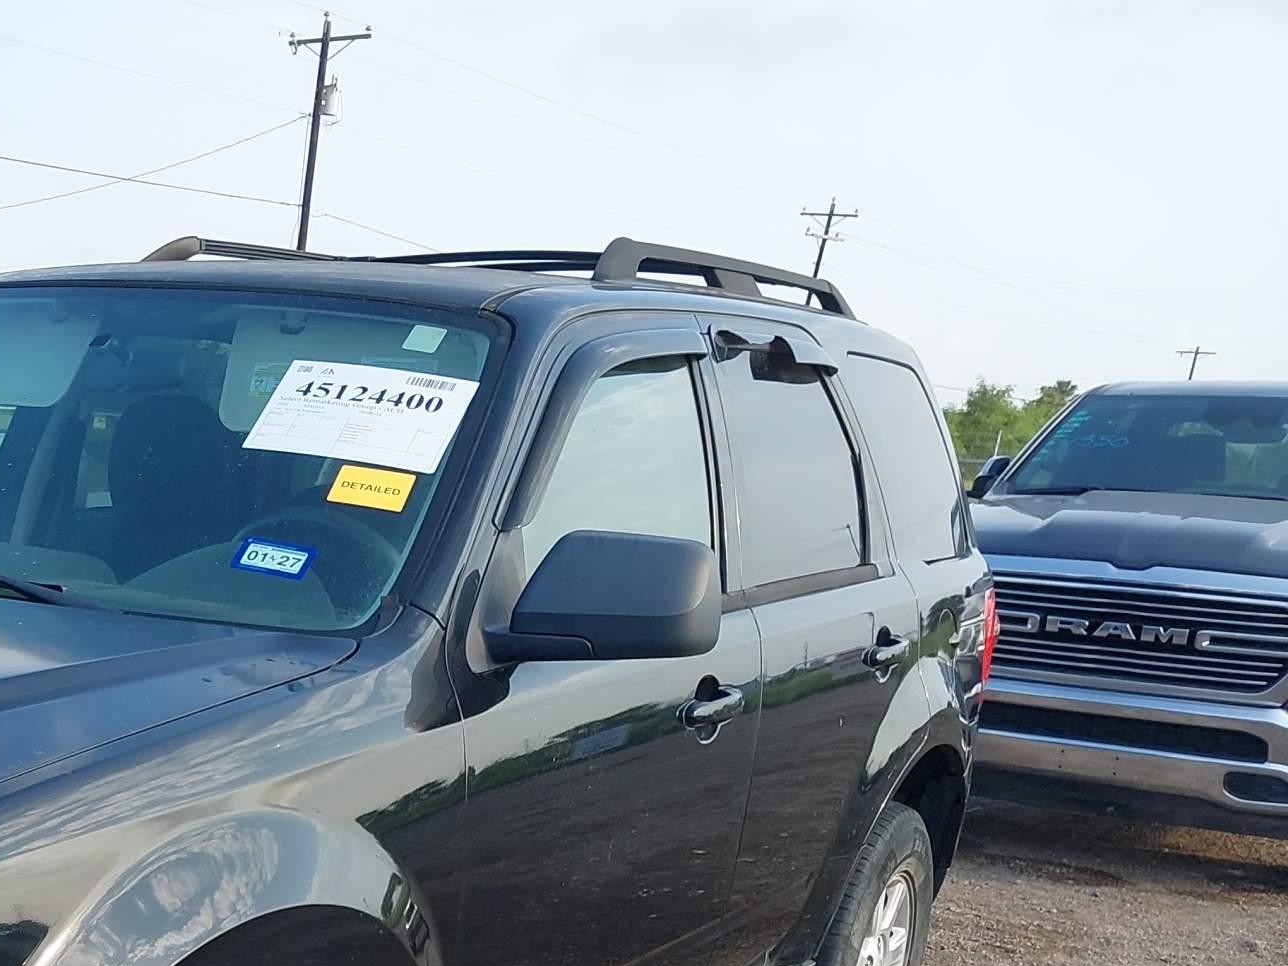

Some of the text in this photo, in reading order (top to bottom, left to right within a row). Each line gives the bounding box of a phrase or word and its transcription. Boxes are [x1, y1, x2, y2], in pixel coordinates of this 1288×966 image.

[296, 381, 444, 413] 45124400
[341, 480, 401, 496] DETAILED
[247, 550, 269, 563] 01
[276, 555, 302, 568] 27
[1045, 615, 1190, 645] RAM
